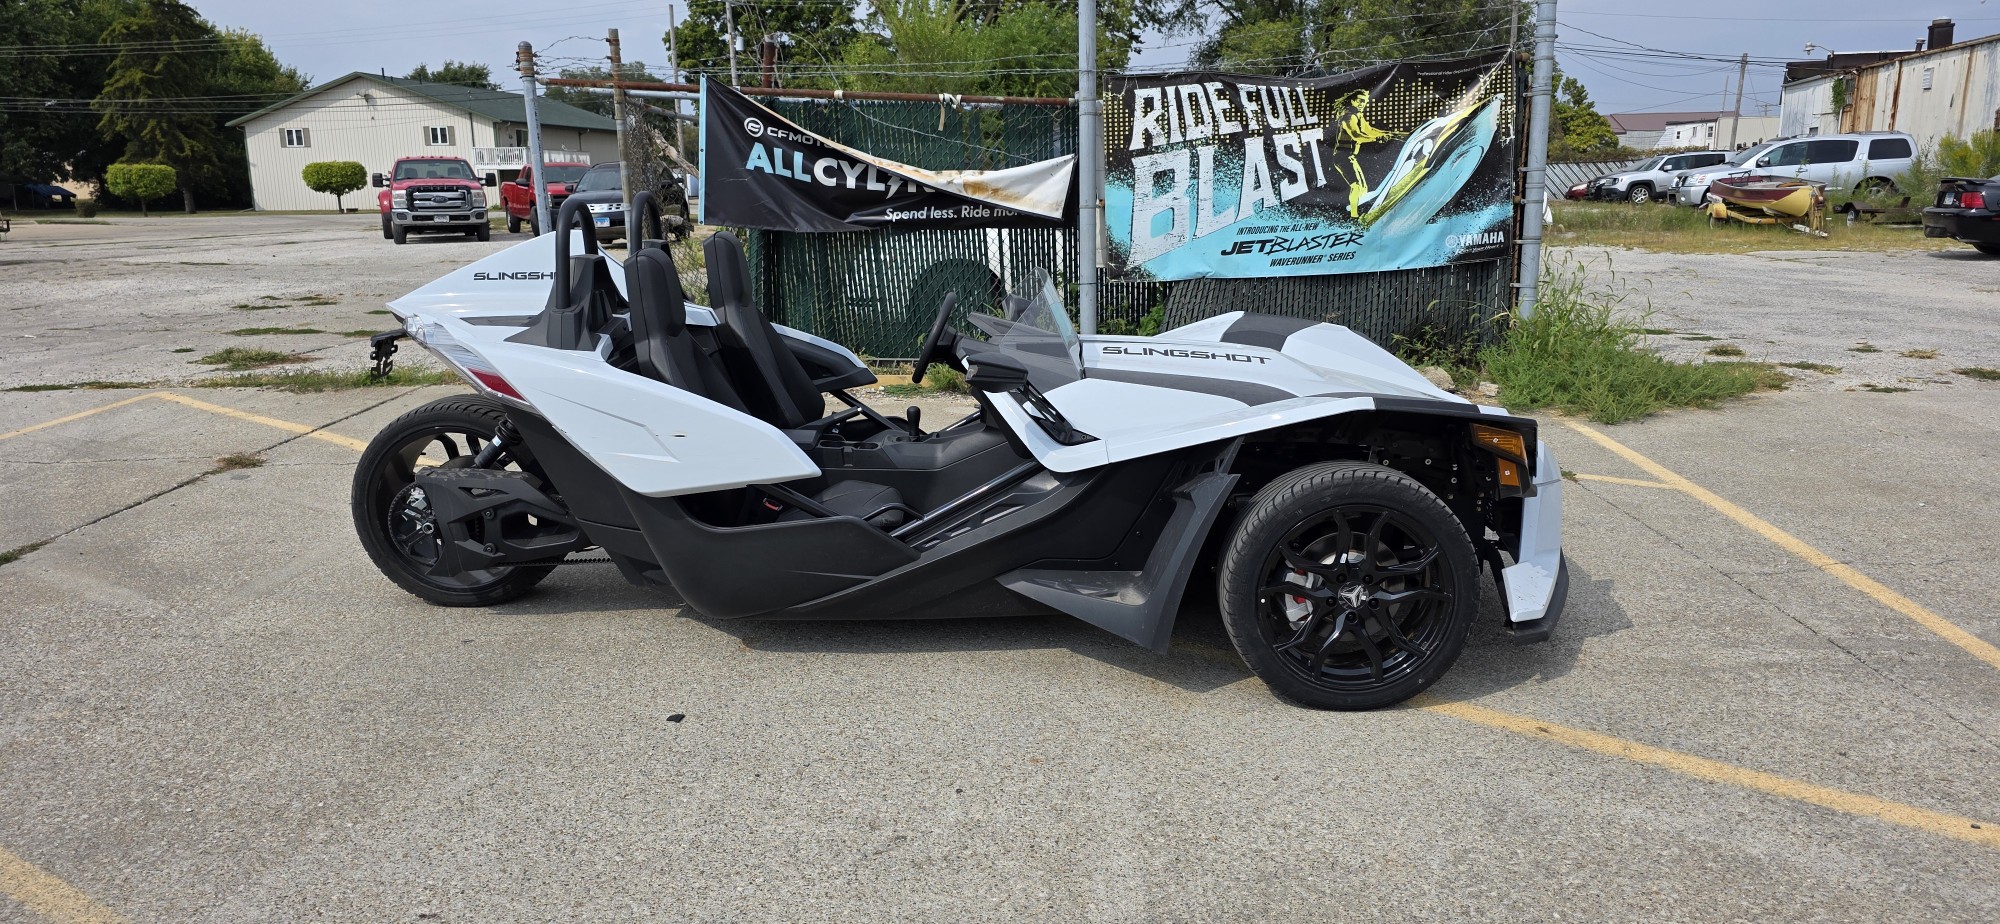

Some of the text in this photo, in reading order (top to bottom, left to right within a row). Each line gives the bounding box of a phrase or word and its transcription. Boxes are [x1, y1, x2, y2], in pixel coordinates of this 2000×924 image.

[1129, 82, 1319, 151] RIDE FULL
[767, 127, 833, 149] CFMOT
[746, 142, 811, 182] ALL
[1126, 128, 1327, 270] BLAST
[884, 205, 1025, 222] Spend less. Ride mo
[1236, 222, 1320, 235] INTRODUCING THE ALL-NEW
[1221, 232, 1364, 256] JETBLASTER
[1459, 231, 1504, 247] YAMAHA
[1269, 251, 1357, 267] WAVERUNNER SERIES
[473, 271, 556, 281] SLINGSH
[1102, 346, 1272, 365] SLINGSHOT
